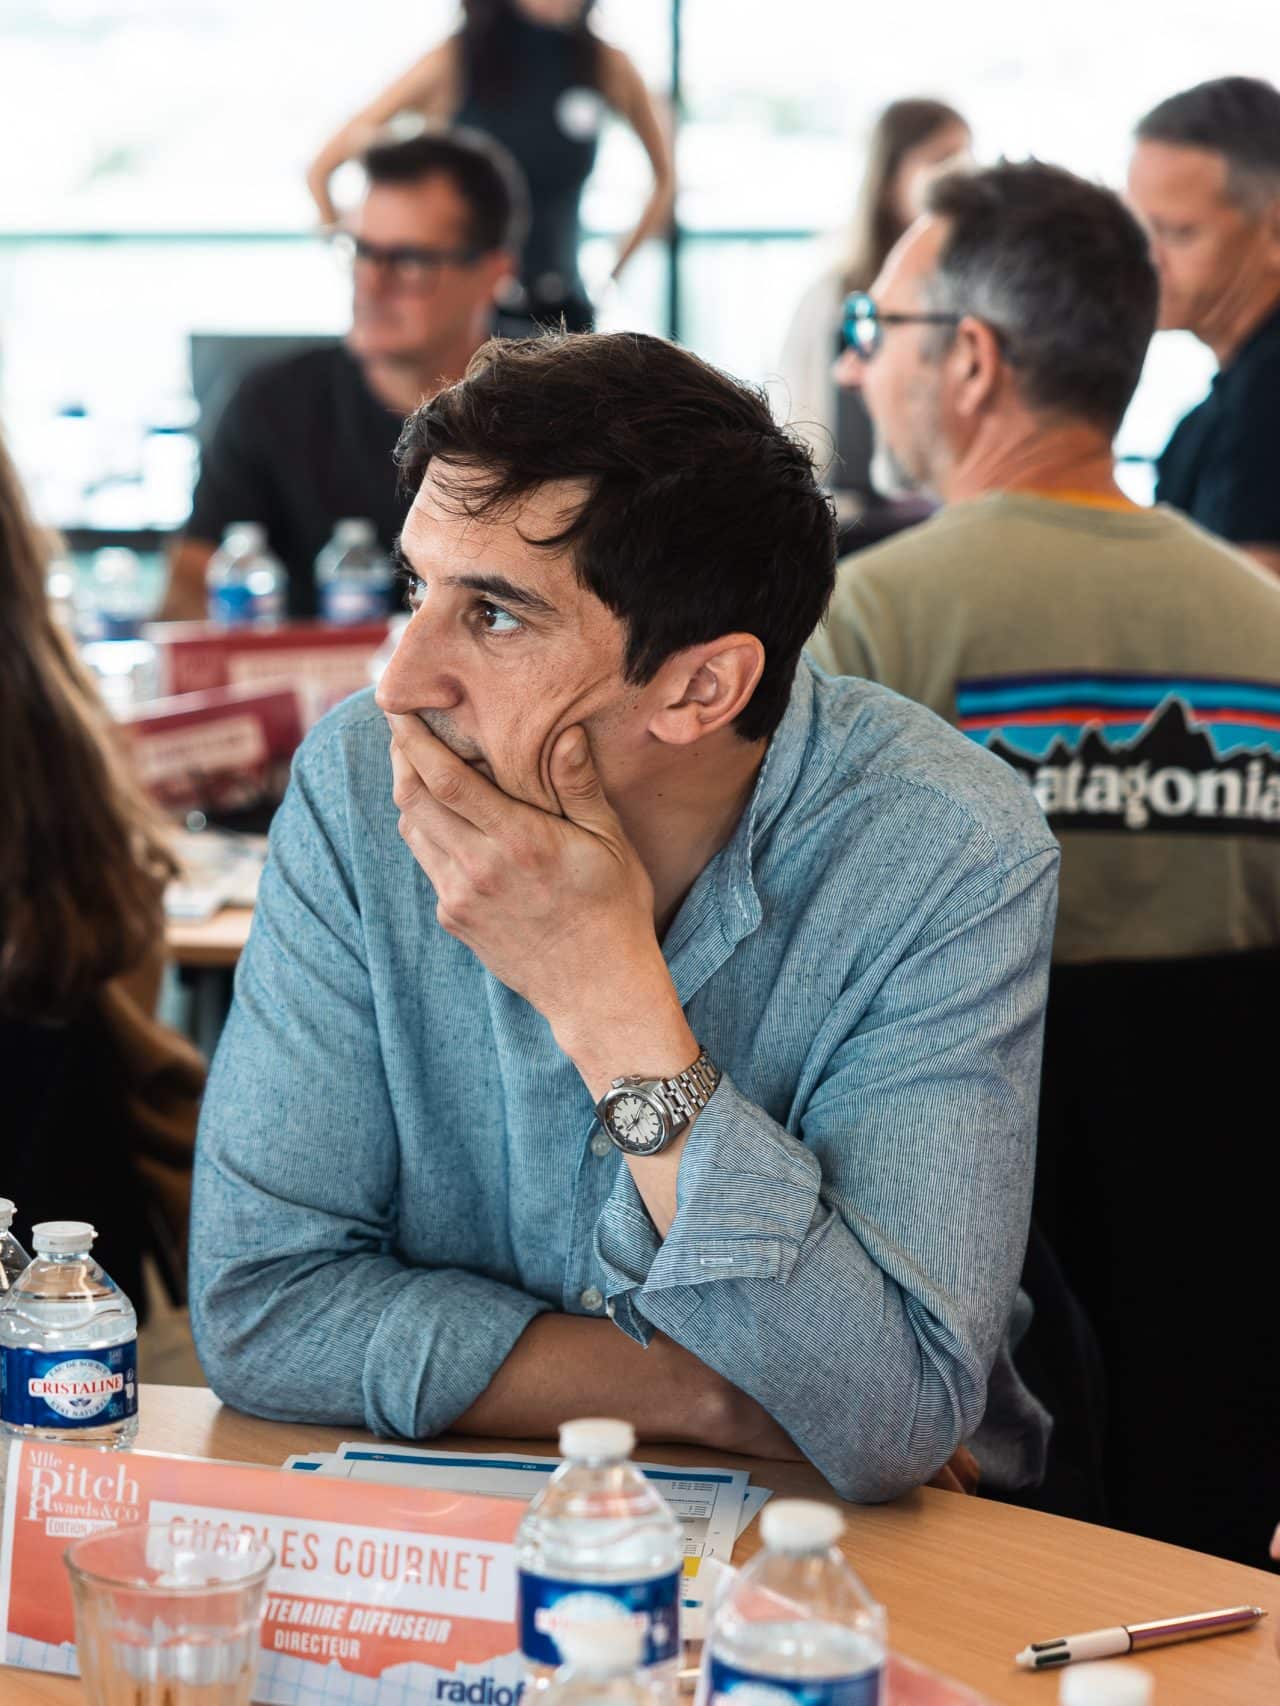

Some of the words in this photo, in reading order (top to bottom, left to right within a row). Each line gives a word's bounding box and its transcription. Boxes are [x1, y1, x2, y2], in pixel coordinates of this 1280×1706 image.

[1032, 758, 1280, 829] atagonia
[30, 1375, 122, 1395] CRISTALINE
[28, 1463, 139, 1521] Pitch
[333, 1536, 496, 1593] COURNET
[260, 1597, 346, 1631] TENAIRE
[348, 1607, 453, 1644] DIFFUSEUR
[274, 1628, 361, 1660] DIRECTEUR
[436, 1676, 526, 1706] radiof
